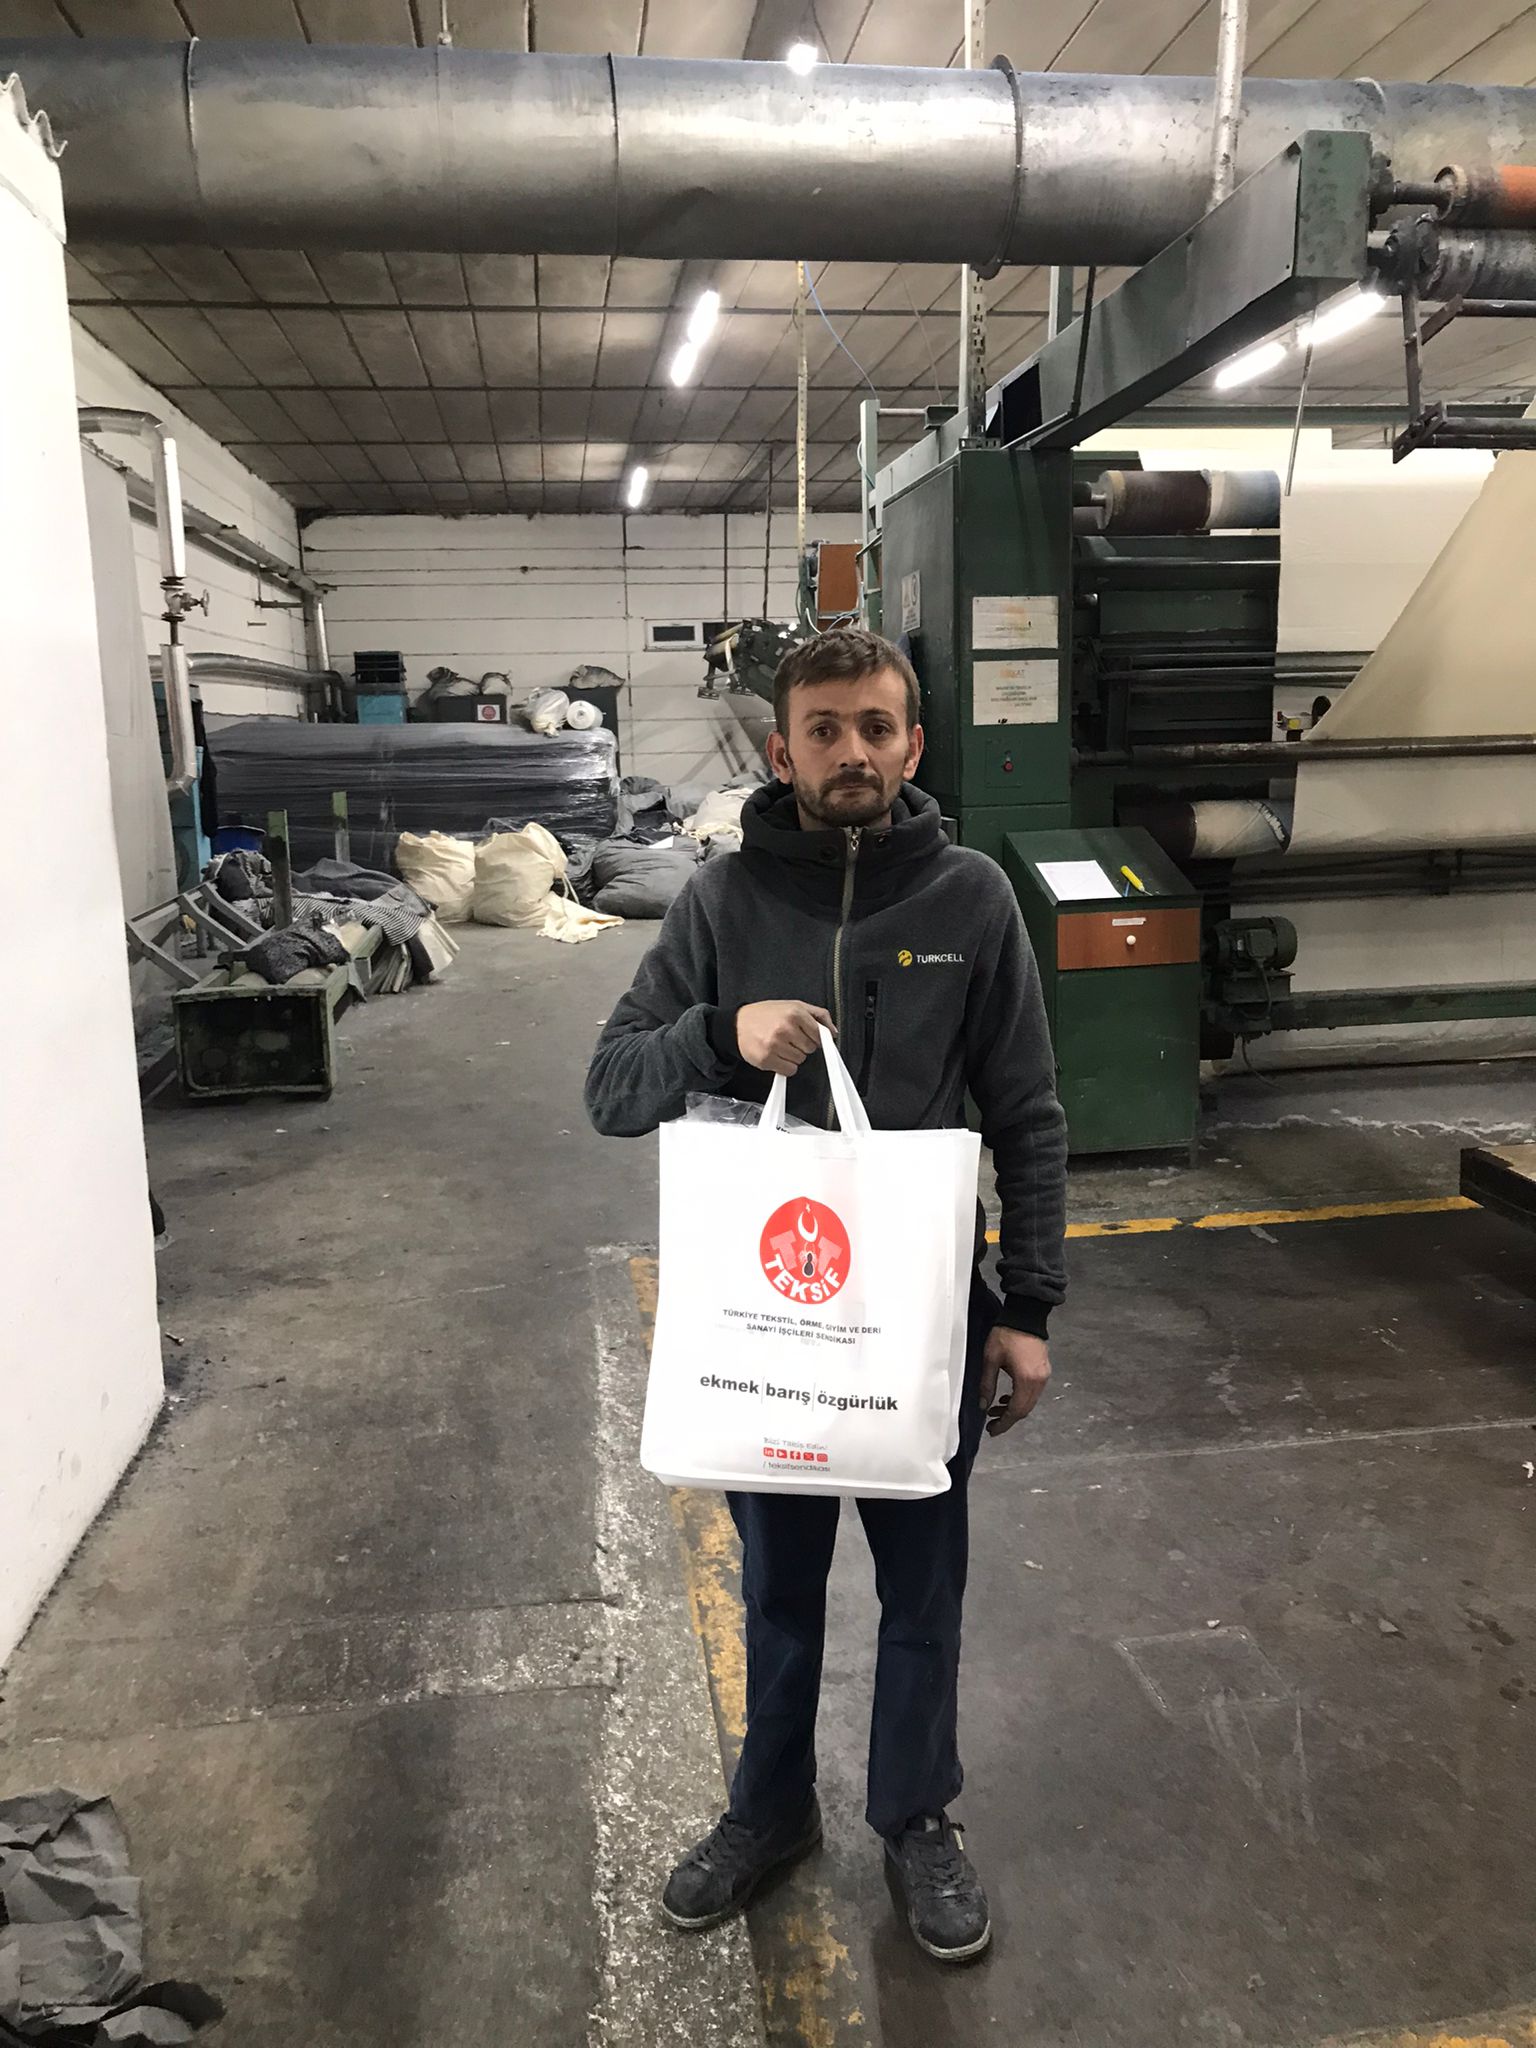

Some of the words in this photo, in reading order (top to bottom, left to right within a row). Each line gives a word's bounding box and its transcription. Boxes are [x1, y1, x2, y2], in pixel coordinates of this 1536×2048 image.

[916, 953, 966, 964] TURKCELL
[722, 1308, 758, 1320] TÜRKİYE
[849, 1326, 860, 1334] VE
[699, 1374, 760, 1395] ekmek
[765, 1382, 811, 1406] barış
[817, 1390, 899, 1411] özgürlük
